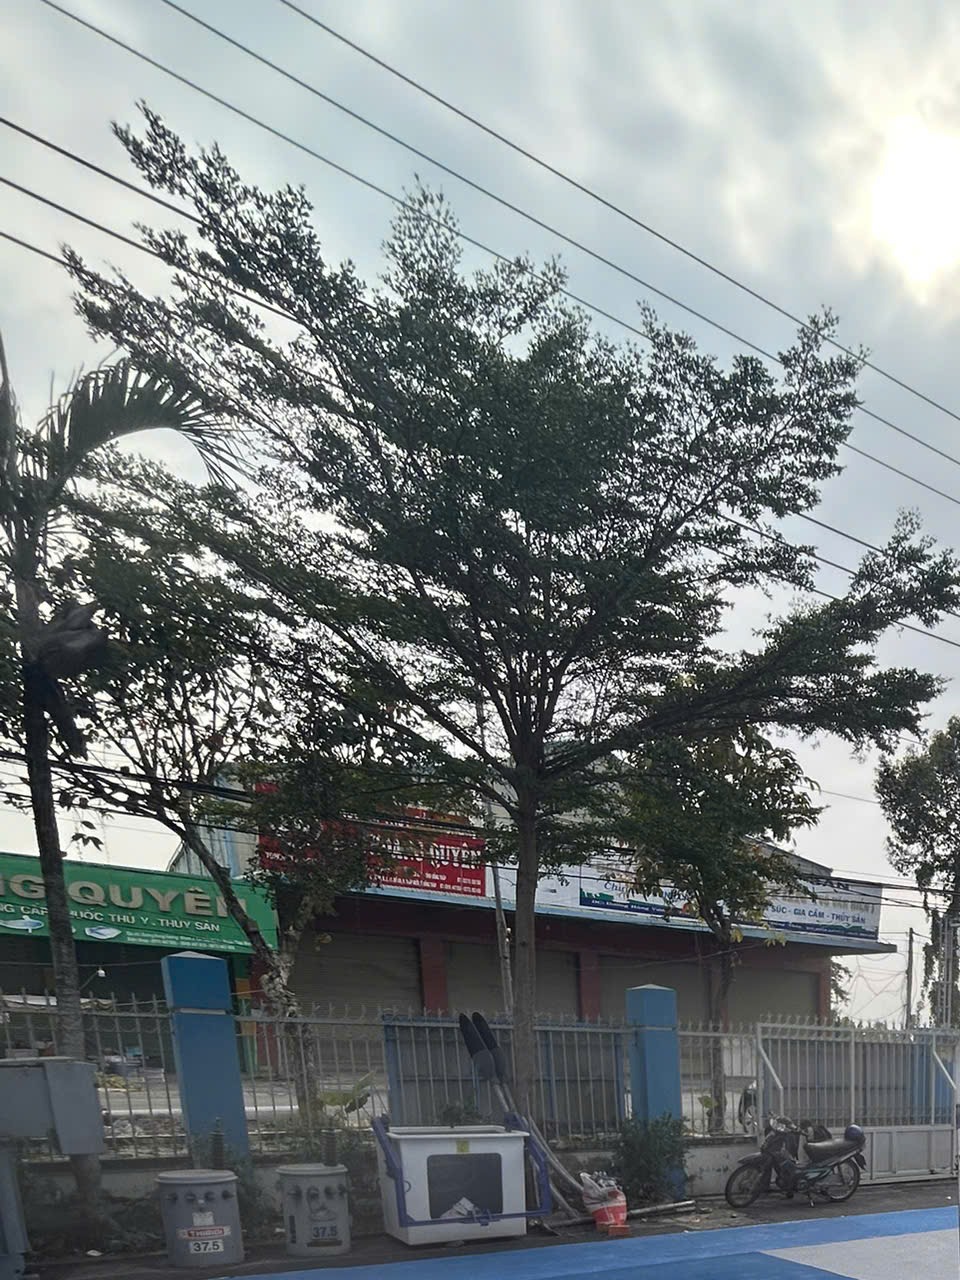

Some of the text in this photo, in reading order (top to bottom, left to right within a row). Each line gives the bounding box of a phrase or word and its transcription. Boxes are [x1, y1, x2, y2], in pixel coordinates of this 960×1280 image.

[0, 873, 46, 899] G
[793, 908, 806, 916] GIA
[140, 916, 149, 925] Y
[193, 1241, 220, 1252] 37.5
